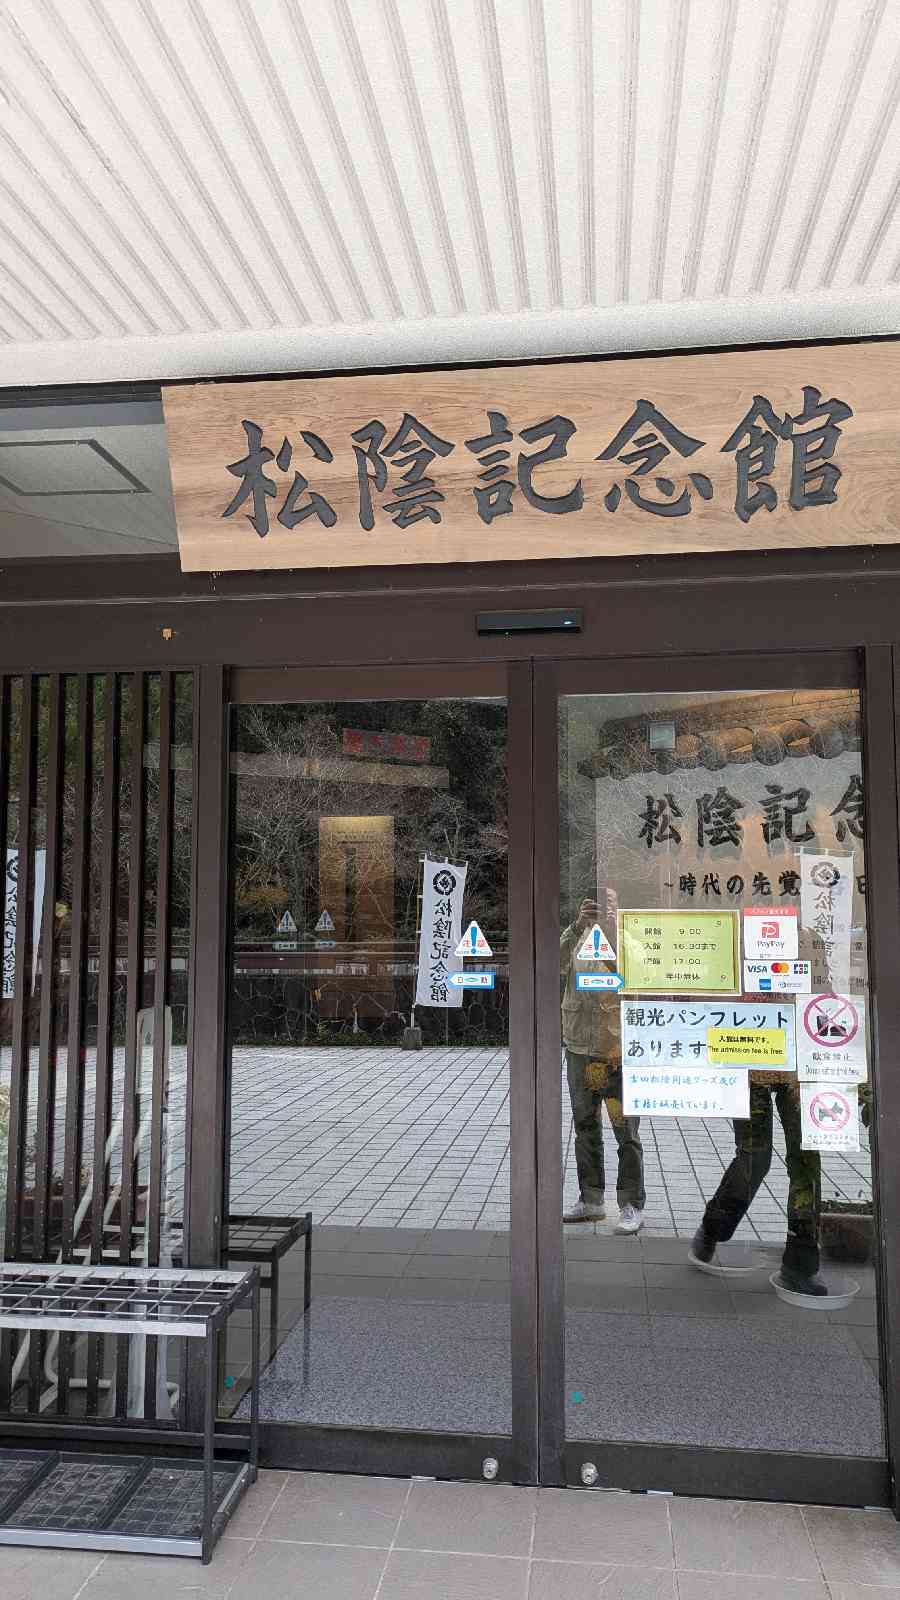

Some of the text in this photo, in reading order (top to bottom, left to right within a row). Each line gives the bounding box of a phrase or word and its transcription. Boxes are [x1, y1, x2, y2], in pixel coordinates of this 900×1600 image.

[221, 385, 853, 538] 松陰記念館
[757, 940, 785, 949] PayPay
[748, 965, 768, 973] VISA
[625, 1007, 789, 1028] 観光パンフレット
[627, 1039, 707, 1058] あります
